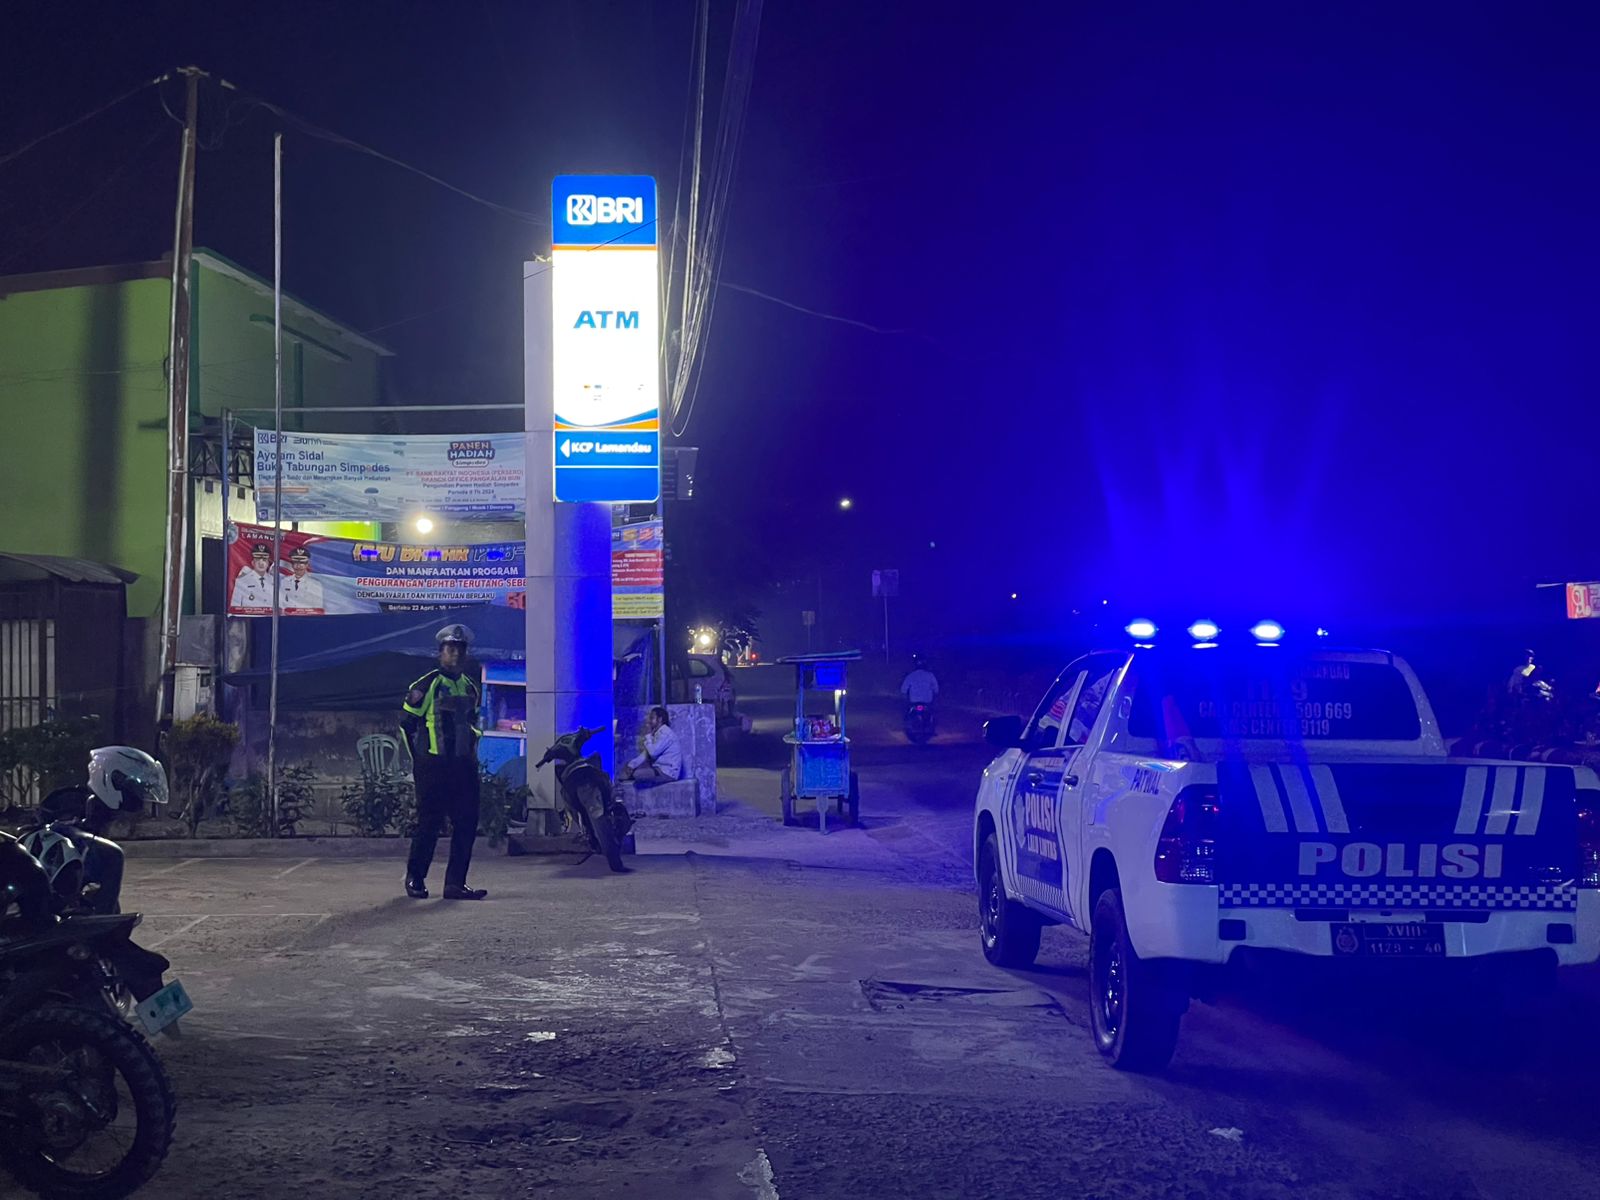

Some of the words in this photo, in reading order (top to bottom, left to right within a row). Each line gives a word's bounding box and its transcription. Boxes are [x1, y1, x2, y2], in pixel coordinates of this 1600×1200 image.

[597, 196, 643, 224] BRI
[573, 311, 639, 329] ATM
[452, 441, 489, 449] PANEN
[571, 442, 594, 453] KCP
[595, 441, 652, 453] Lamandau
[450, 450, 493, 458] HADIAH
[286, 461, 337, 474] Tabungan
[340, 462, 390, 474] Simpedes
[240, 532, 286, 541] LAMANDU
[386, 567, 405, 575] DAN
[407, 567, 471, 576] MANFAATKAN
[472, 566, 518, 576] PROGRAM
[357, 578, 423, 587] PENGURANGAN
[426, 578, 456, 588] BPHTB
[458, 578, 503, 588] TERUTANG
[1325, 702, 1352, 719] 669
[1300, 719, 1330, 736] 9119
[1025, 791, 1055, 833] POLISI
[1298, 842, 1503, 878] POLISI
